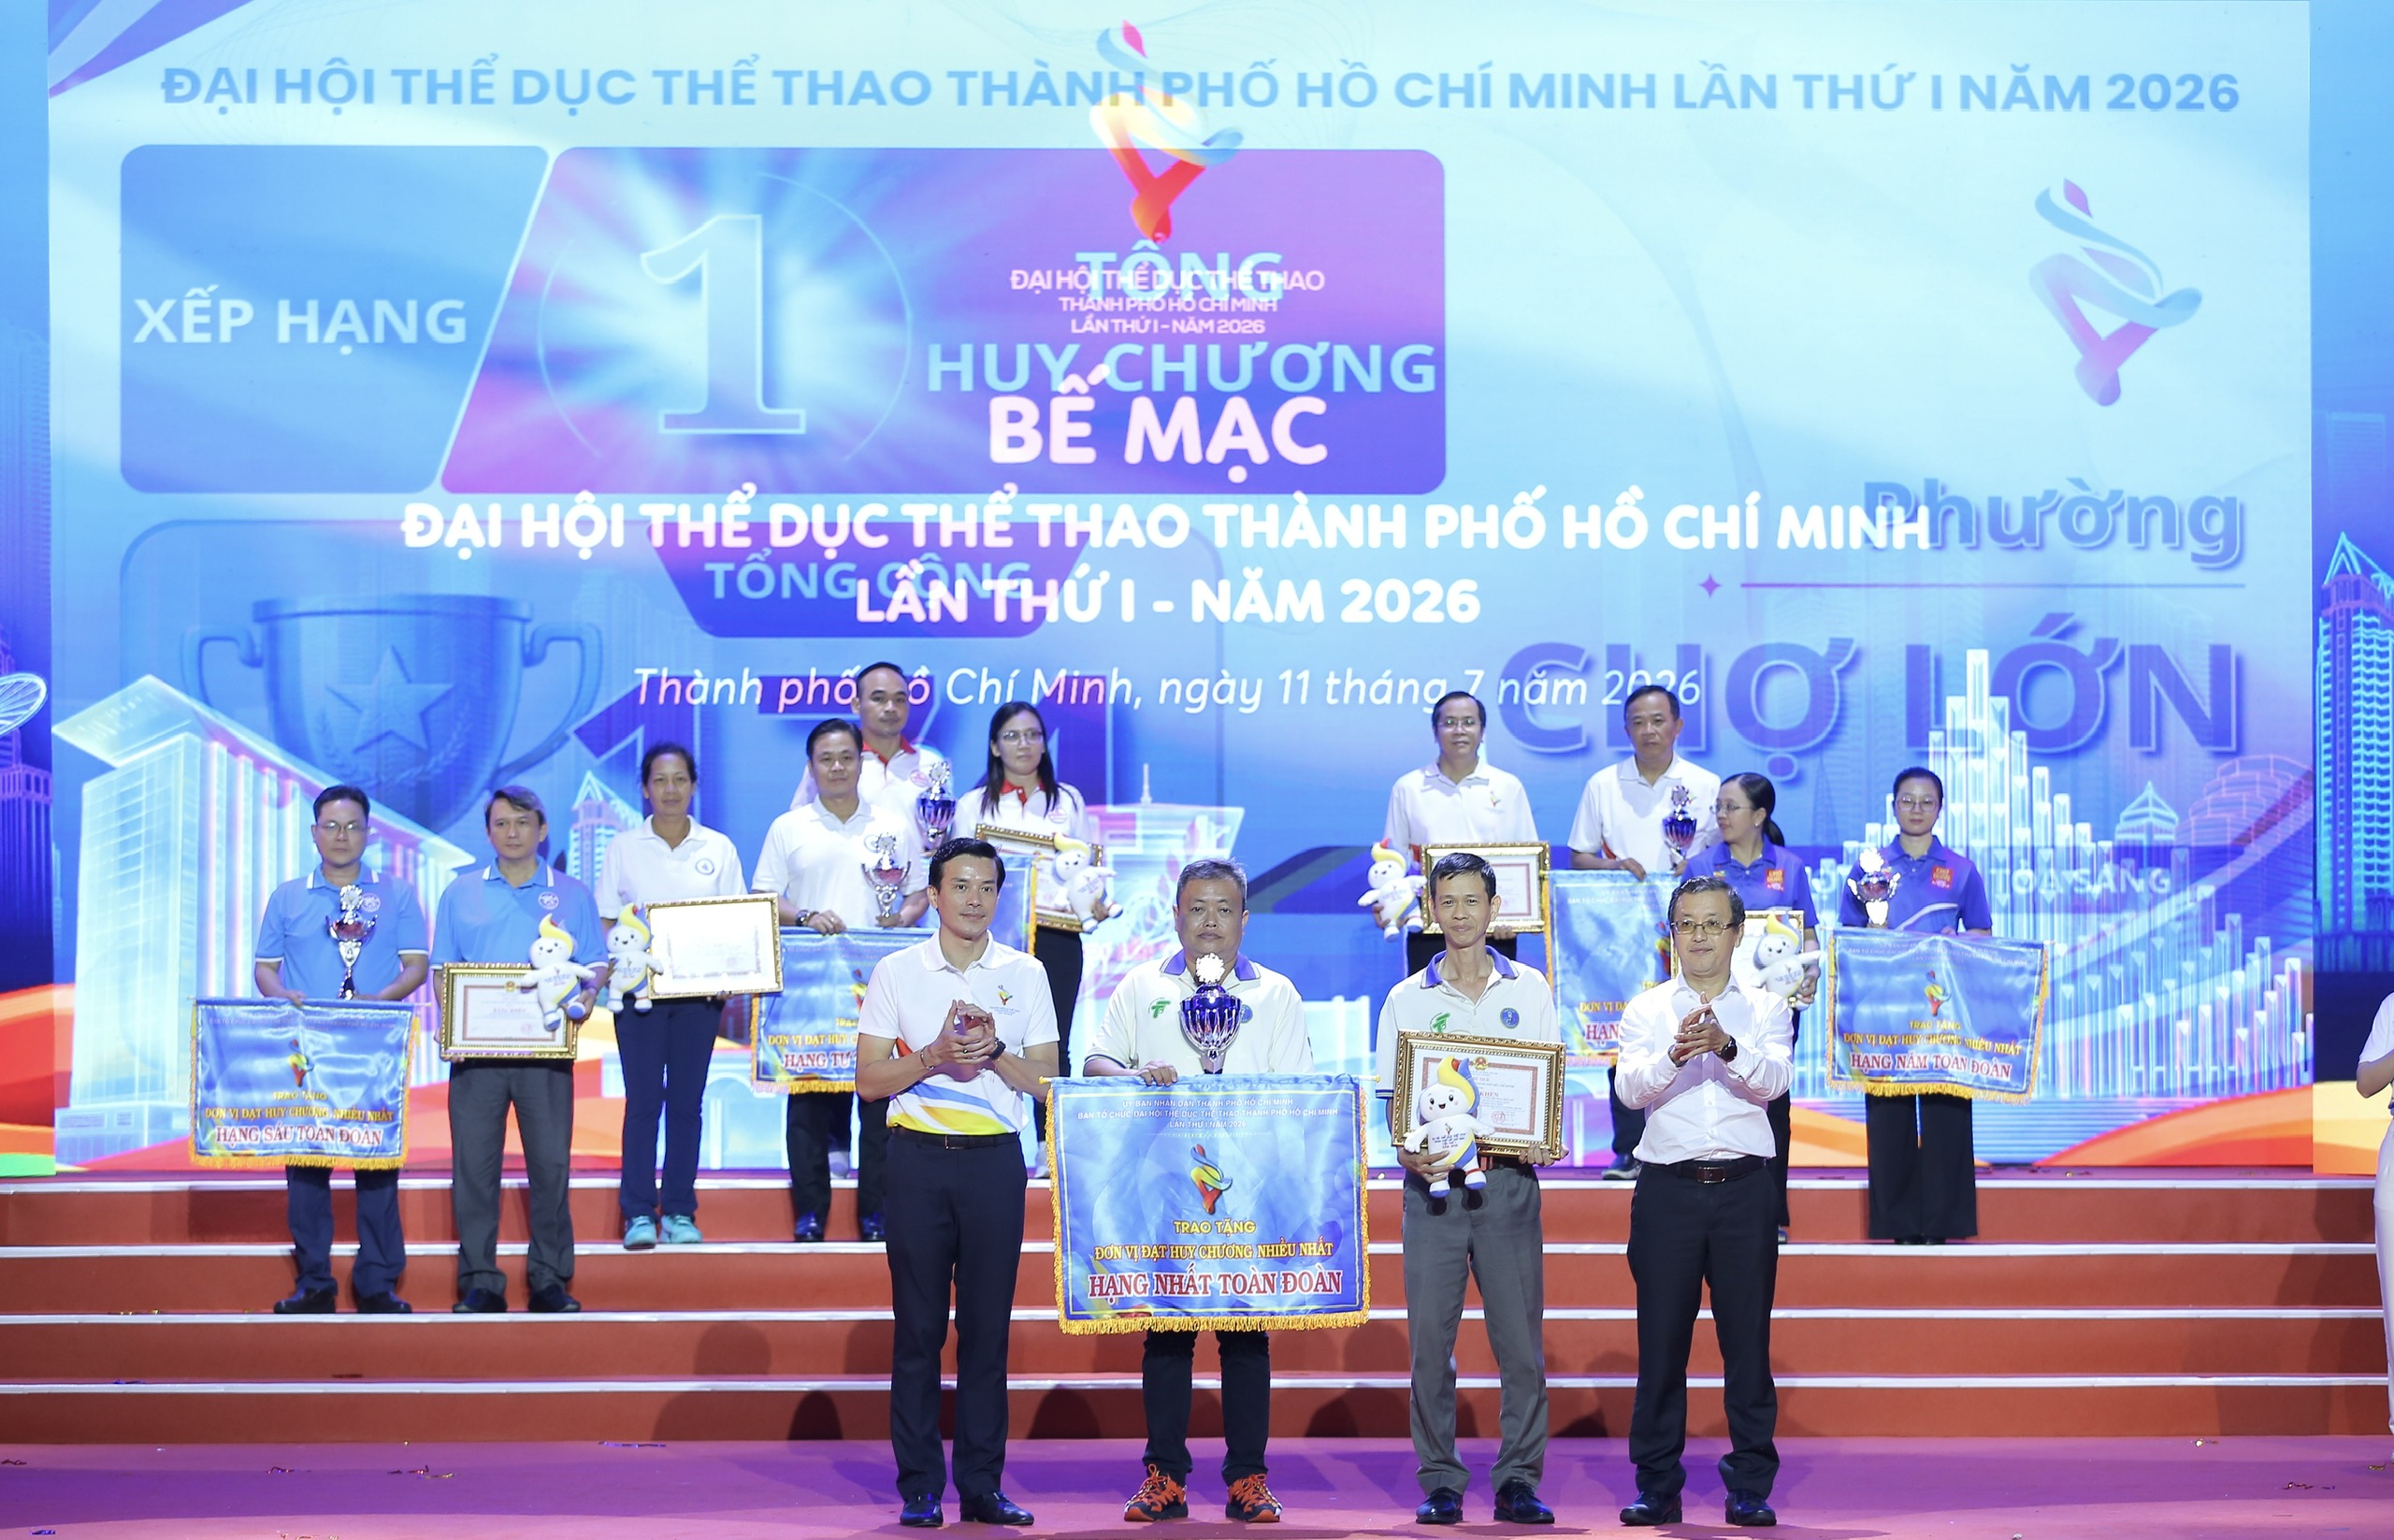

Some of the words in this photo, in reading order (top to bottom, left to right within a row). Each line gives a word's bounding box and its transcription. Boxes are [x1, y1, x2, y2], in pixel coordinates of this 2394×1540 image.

[160, 66, 258, 116] ĐẠI
[275, 57, 375, 116] HỘI
[390, 52, 499, 106] THỂ
[512, 68, 636, 117] DỤC
[652, 53, 760, 107] THỂ
[772, 69, 932, 108] THAO
[946, 58, 1145, 108] THÀNH
[1162, 58, 1279, 108] PHỐ
[1297, 58, 1378, 108] HỒ
[1394, 61, 1493, 109] CHÍ
[1510, 72, 1656, 109] MINH
[1674, 60, 1777, 110] LẦN
[1793, 63, 1917, 111] THỨ
[1932, 74, 1942, 111] I
[1960, 63, 2090, 111] NĂM
[2106, 73, 2240, 112] 2026
[1010, 270, 1052, 295] ĐẠI
[1056, 266, 1098, 295] HỘI
[1105, 261, 1149, 291] THỂ
[1152, 270, 1204, 295] DỤC
[1256, 270, 1325, 292] THAO
[133, 284, 254, 344] XẾP
[277, 299, 468, 355] HẠNG
[1231, 296, 1277, 312] MINH
[641, 214, 807, 435] 1
[1071, 313, 1108, 334] LẦN
[1111, 315, 1152, 334] THỨ
[1172, 316, 1215, 334] NĂM
[1217, 319, 1266, 334] 2026
[927, 342, 1082, 393] HUY
[1102, 341, 1436, 394] CHƯƠNG
[988, 363, 1111, 465] BẾ
[1124, 396, 1328, 483] MẠC
[401, 503, 502, 560] ĐẠI
[521, 490, 626, 560] HỘI
[639, 482, 758, 548] THỂ
[769, 503, 889, 560] DỤC
[901, 482, 1018, 548] THỂ
[1026, 503, 1191, 549] THAO
[1202, 490, 1406, 549] THÀNH
[1425, 483, 1548, 549] PHỐ
[1563, 483, 1649, 550] HỒ
[1663, 490, 1762, 550] CHÍ
[1776, 504, 1931, 550] MINH
[1863, 478, 2244, 569] Phường
[704, 548, 857, 599] TỔNG
[856, 558, 969, 624] LẦN
[981, 562, 1111, 624] THỨ
[1122, 578, 1135, 624] I
[1190, 566, 1326, 624] NĂM
[1340, 578, 1481, 624] 2026
[634, 668, 763, 706] Thành
[777, 665, 861, 713] phố
[908, 665, 930, 705] ồ
[945, 667, 1020, 706] Chí
[1031, 668, 1142, 710] Minh,
[1159, 669, 1262, 713] ngày
[1278, 669, 1310, 705] 11
[1324, 669, 1448, 714] tháng
[1464, 669, 1485, 697] 7
[1497, 671, 1587, 706] năm
[1498, 638, 1859, 782] CHỢ
[1584, 1022, 1620, 1046] HẠN
[1843, 1031, 1864, 1044] ĐƠN
[1866, 1033, 1877, 1048] VỊ
[1879, 1033, 1899, 1048] ĐẠT
[1901, 1033, 1923, 1045] HUY
[784, 1053, 828, 1073] HẠNG
[829, 1051, 852, 1069] TƯ
[1850, 1052, 1893, 1074] HẠNG
[1895, 1050, 1928, 1070] NĂM
[1932, 1051, 1969, 1072] TOÀN
[1970, 1057, 2013, 1081] ĐOÀN
[205, 1106, 227, 1120] ĐƠN
[229, 1107, 240, 1122] VỊ
[241, 1107, 263, 1122] ĐẠT
[265, 1106, 286, 1119] HUY
[1077, 1112, 1093, 1120] BAN
[1181, 1110, 1198, 1119] DỤC
[1219, 1109, 1240, 1117] THAO
[1318, 1108, 1338, 1116] MINH
[1135, 1099, 1152, 1108] BAN
[1273, 1098, 1293, 1106] MINH
[215, 1125, 260, 1148] HẠNG
[262, 1122, 294, 1142] SÁU
[296, 1121, 336, 1143] TOÀN
[339, 1122, 383, 1146] ĐOÀN
[1174, 1220, 1212, 1234] TRAO
[1215, 1217, 1256, 1237] TẶNG
[1094, 1243, 1123, 1260] ĐƠN
[1124, 1244, 1139, 1263] VỊ
[1141, 1245, 1168, 1263] ĐẠT
[1170, 1244, 1196, 1259] HUY
[1198, 1242, 1253, 1259] CHƯƠNG
[1257, 1236, 1296, 1259] NHIỀU
[1299, 1235, 1334, 1258] NHẤT
[1088, 1272, 1149, 1305] HẠNG
[1153, 1262, 1213, 1296] NHẤT
[1218, 1264, 1278, 1296] TOÀN
[1281, 1262, 1344, 1294] ĐOÀN
